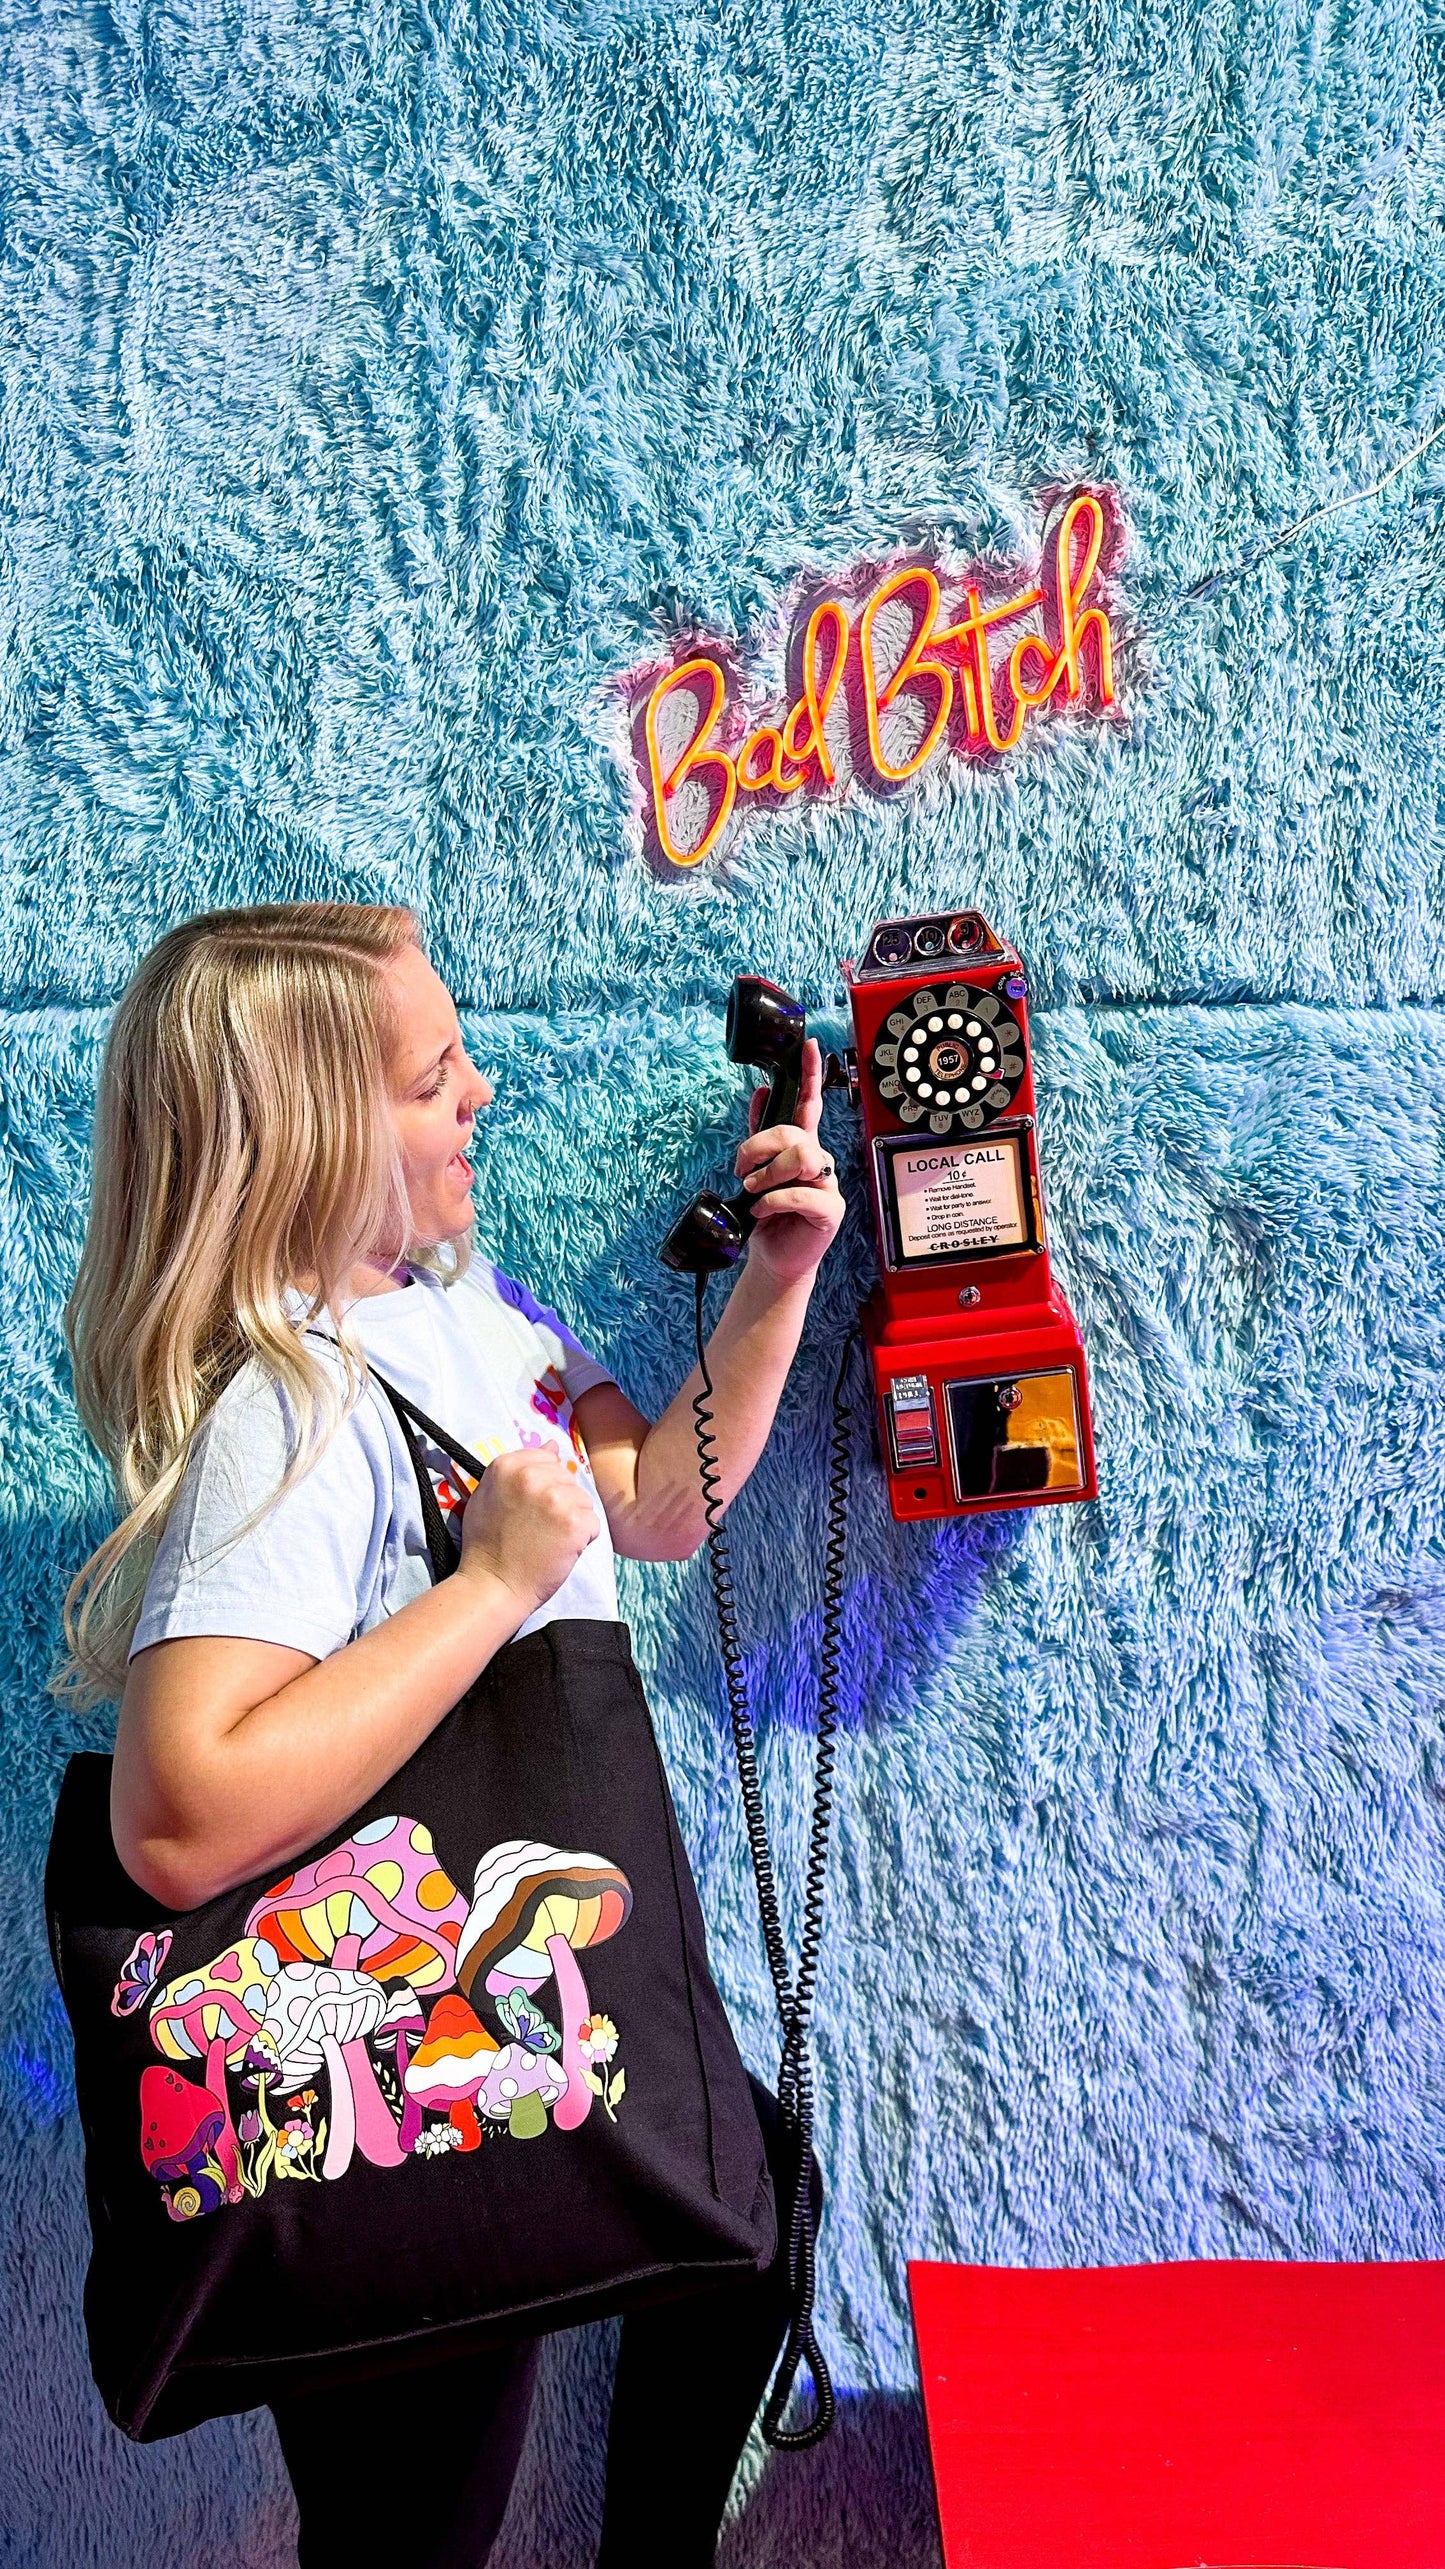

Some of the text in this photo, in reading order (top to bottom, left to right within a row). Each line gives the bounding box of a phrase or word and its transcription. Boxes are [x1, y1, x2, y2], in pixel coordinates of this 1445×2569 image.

[645, 495, 1115, 869] Bad Bitch
[948, 989, 966, 999] ABC
[916, 995, 932, 1005] DEF
[889, 1018, 904, 1026] GHI
[936, 1041, 960, 1051] PUBLIC
[879, 1049, 893, 1057] JKL
[938, 1055, 959, 1066] 1957
[882, 1080, 900, 1088] MNO
[902, 1105, 918, 1113] PRS
[961, 1108, 980, 1118] WYZ
[934, 1114, 949, 1122] TUV
[907, 1149, 1005, 1173] LOCAL CALL
[928, 1186, 952, 1194] Remove
[951, 1202, 965, 1210] party
[927, 1216, 998, 1233] LONG DISTANCE
[908, 1233, 931, 1242] Deposit
[931, 1231, 947, 1239] coins
[956, 1226, 985, 1236] requested
[985, 1224, 993, 1232] by
[993, 1221, 1018, 1231] operator
